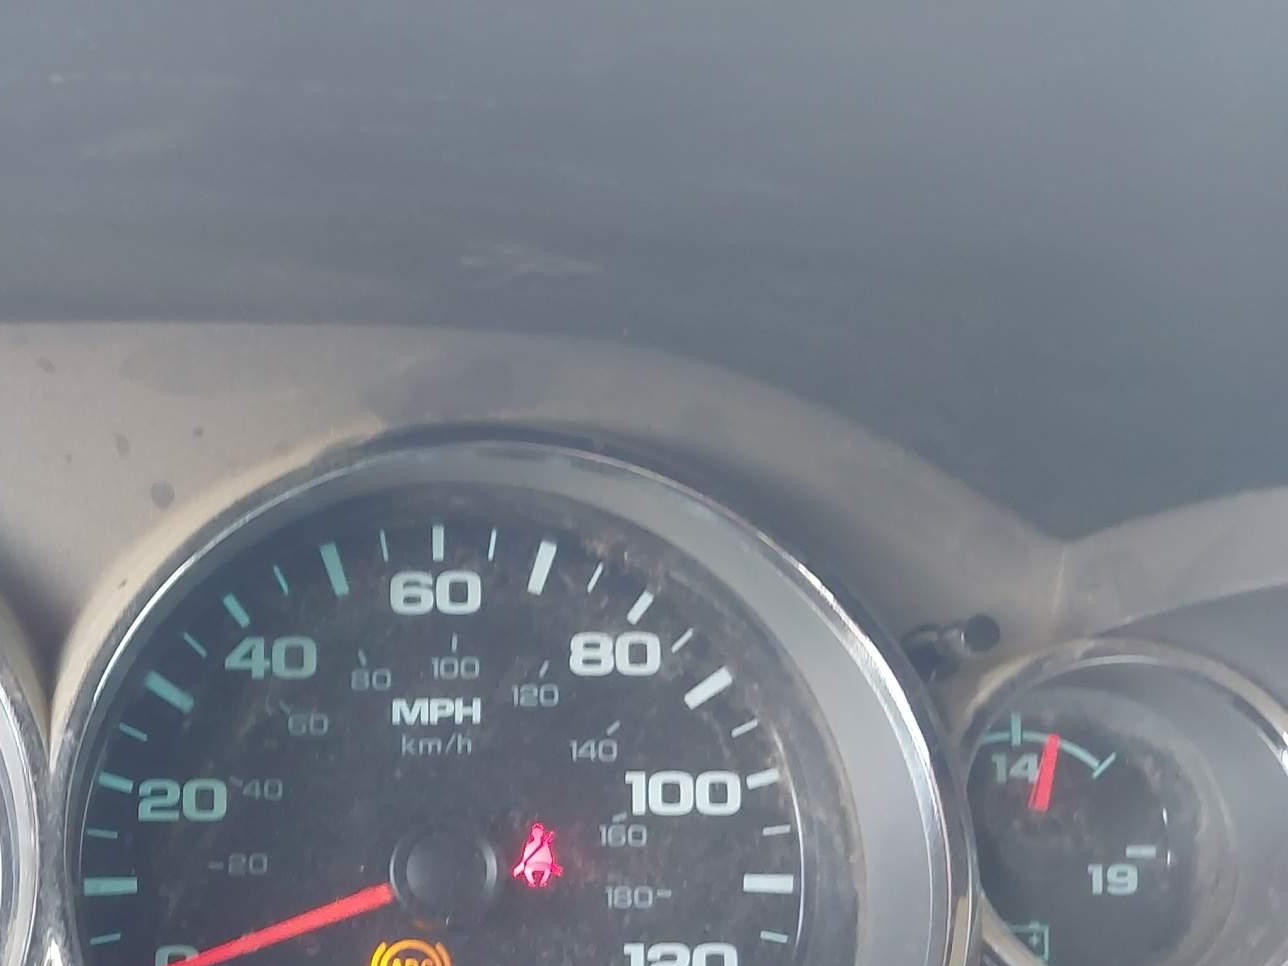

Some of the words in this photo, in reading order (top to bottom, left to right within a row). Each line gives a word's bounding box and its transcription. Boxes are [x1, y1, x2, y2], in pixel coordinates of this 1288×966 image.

[389, 570, 481, 616] 60
[224, 636, 317, 681] 40
[569, 632, 661, 677] 80
[351, 667, 392, 691] 80
[430, 656, 480, 680] 100
[513, 683, 559, 708] 120
[287, 712, 329, 736] 60
[391, 697, 481, 726] MPH
[401, 734, 472, 756] km/h
[569, 738, 618, 763] 140
[991, 752, 1040, 785] 14
[137, 778, 228, 823] 20
[242, 778, 283, 801] 40
[625, 770, 742, 817] 100
[599, 823, 648, 848] 160
[227, 852, 268, 876] 20
[1087, 863, 1139, 897] 19
[605, 884, 654, 910] 180
